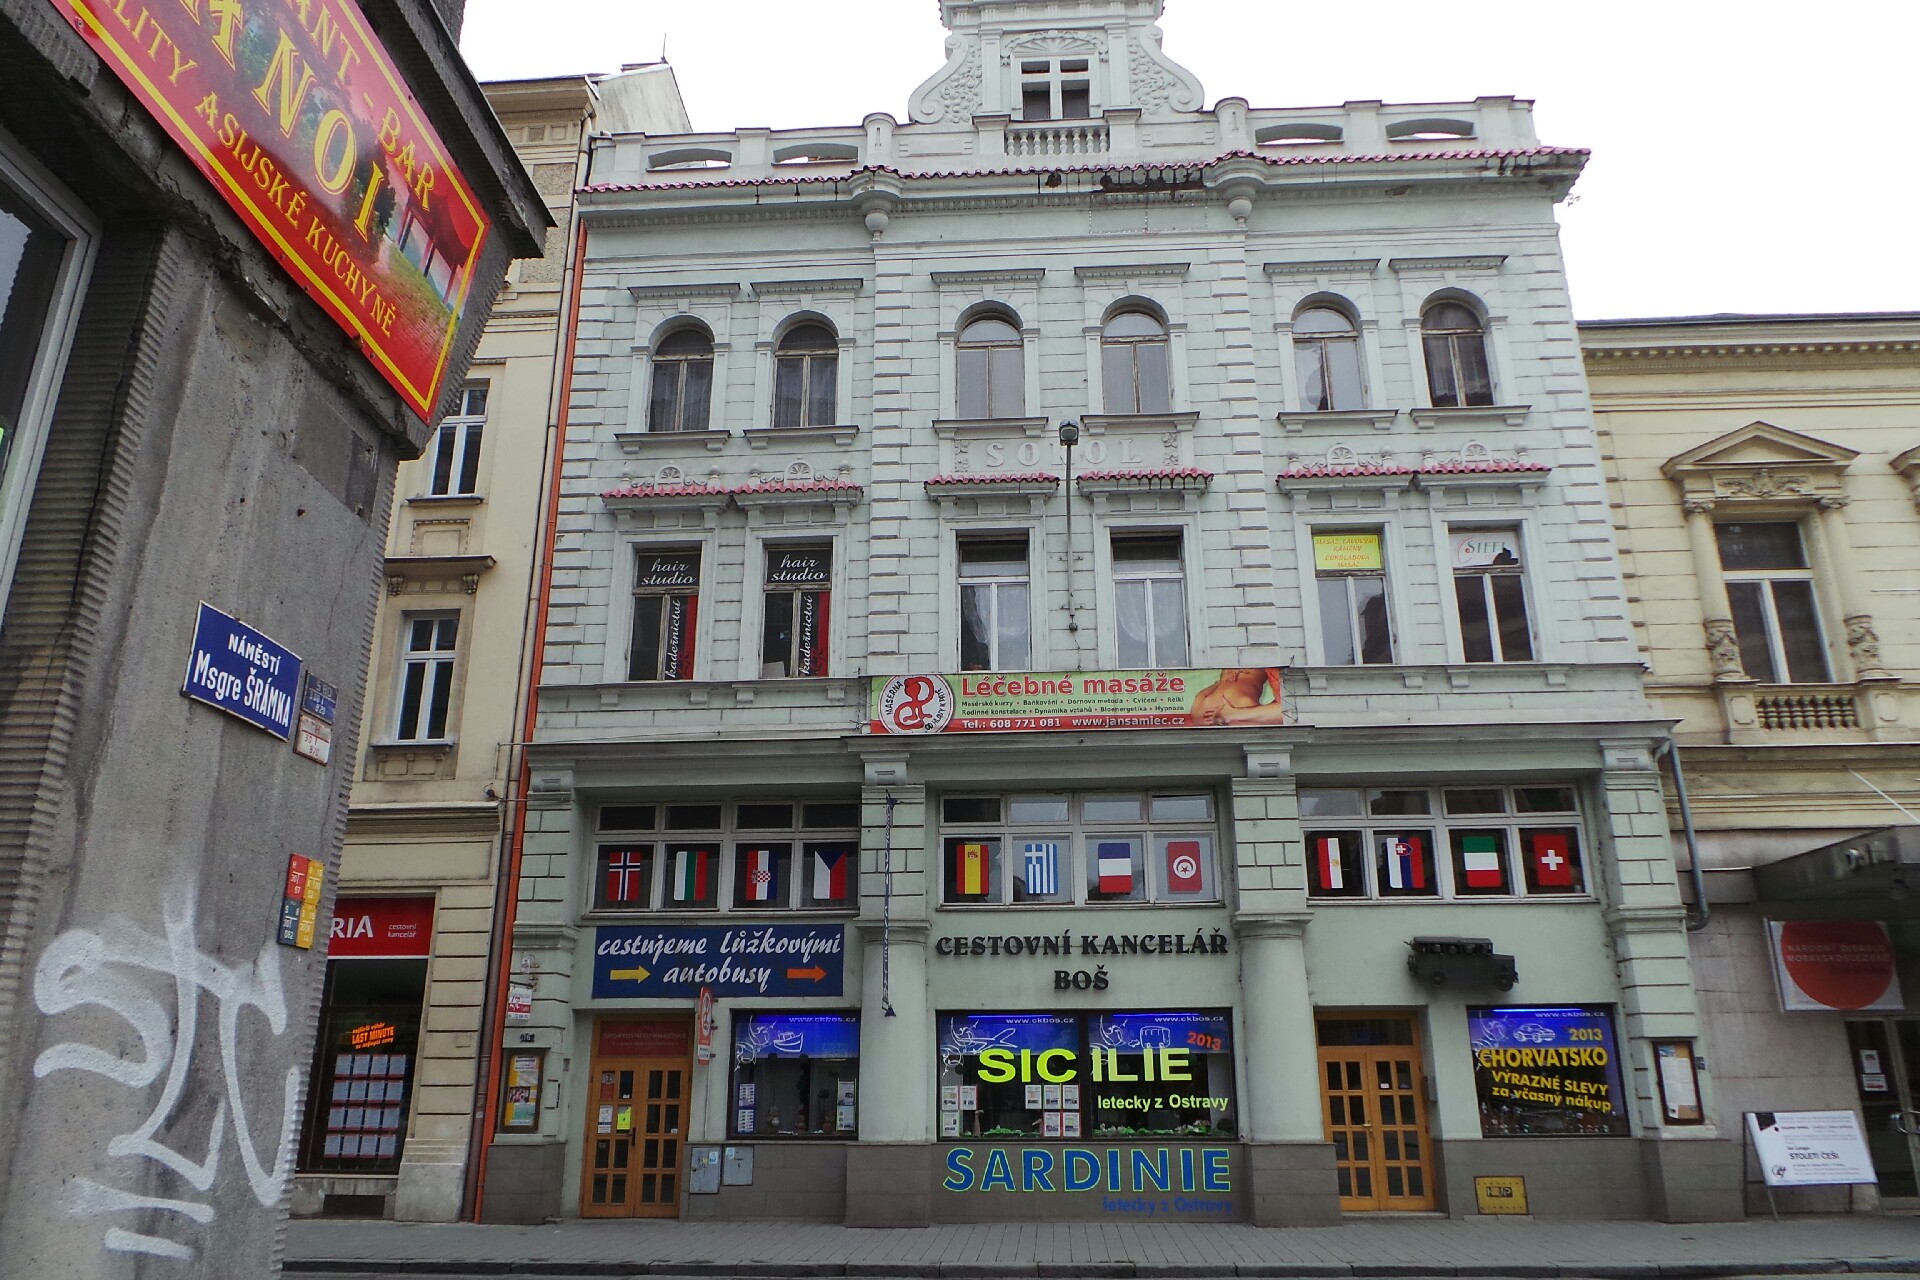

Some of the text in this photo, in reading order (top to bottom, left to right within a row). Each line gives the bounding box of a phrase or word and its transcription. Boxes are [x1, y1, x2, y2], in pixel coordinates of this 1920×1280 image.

[378, 106, 434, 211] BAR
[195, 91, 306, 228] ASIJSKÉ
[305, 216, 398, 338] KUCHYNĚ
[650, 557, 690, 572] hair
[780, 553, 819, 568] hair
[641, 571, 697, 586] studio
[770, 566, 828, 582] studio
[228, 632, 280, 676] NÁMĚSTÍ
[193, 649, 241, 701] Msgre
[962, 672, 1185, 697] Léčebné masáže
[244, 668, 292, 728] ŠRÁMKA
[962, 715, 1185, 728] Tel.: 608 771 081 www.jansamiec.cz
[329, 915, 374, 939] RIA
[597, 927, 841, 965] cestujeme lůžkovými
[935, 927, 1229, 957] CESTOVNÍ KANCELÁŘ
[662, 956, 772, 993] autobusy
[1053, 964, 1110, 991] BOŠ
[1005, 1016, 1075, 1024] www.ckbos.cz
[1154, 1015, 1225, 1023] www.ckbos.cz
[352, 1026, 394, 1045] LAST MINUTE
[1186, 1031, 1222, 1051] 2013
[1568, 1028, 1603, 1041] 2013
[1479, 1046, 1608, 1068] CHORVATSKO
[1492, 1068, 1608, 1096] VÝRAZNÉ SLEVY
[1097, 1095, 1151, 1113] letecky
[1154, 1098, 1164, 1109] z
[1168, 1093, 1229, 1112] Ostravy
[1492, 1087, 1613, 1114] za včasný nákup
[942, 1147, 1231, 1193] SARDINIE
[1102, 1196, 1156, 1216] letecky
[1174, 1196, 1233, 1216] Ostravy
